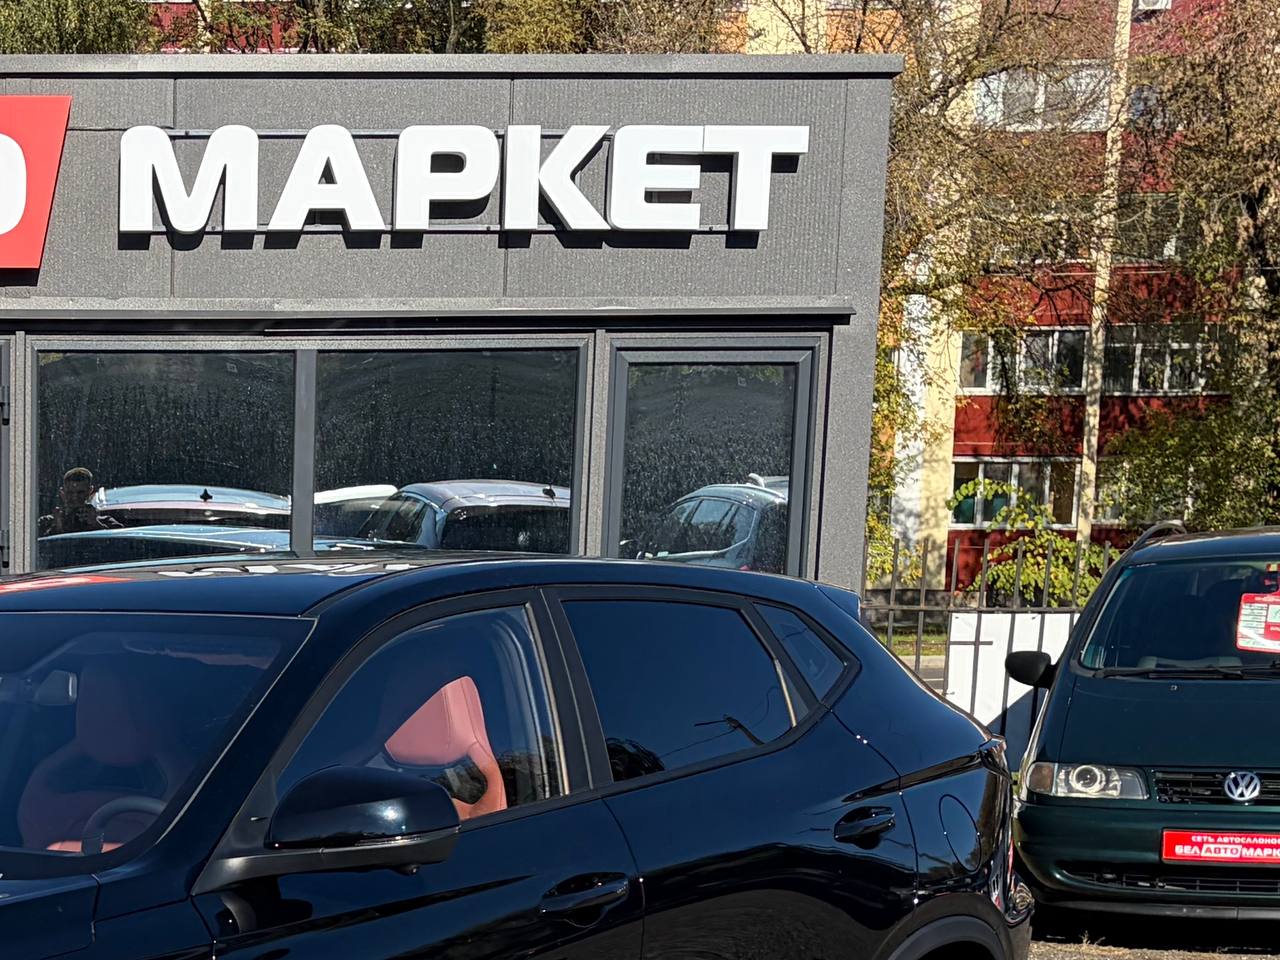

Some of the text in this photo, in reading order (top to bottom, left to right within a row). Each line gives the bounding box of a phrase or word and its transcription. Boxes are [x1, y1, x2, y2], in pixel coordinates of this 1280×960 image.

[119, 124, 810, 232] МАРКЕТ
[1191, 835, 1215, 843] СЕТЬ
[1174, 844, 1200, 857] БЕЛ
[1203, 845, 1239, 857] АВТО
